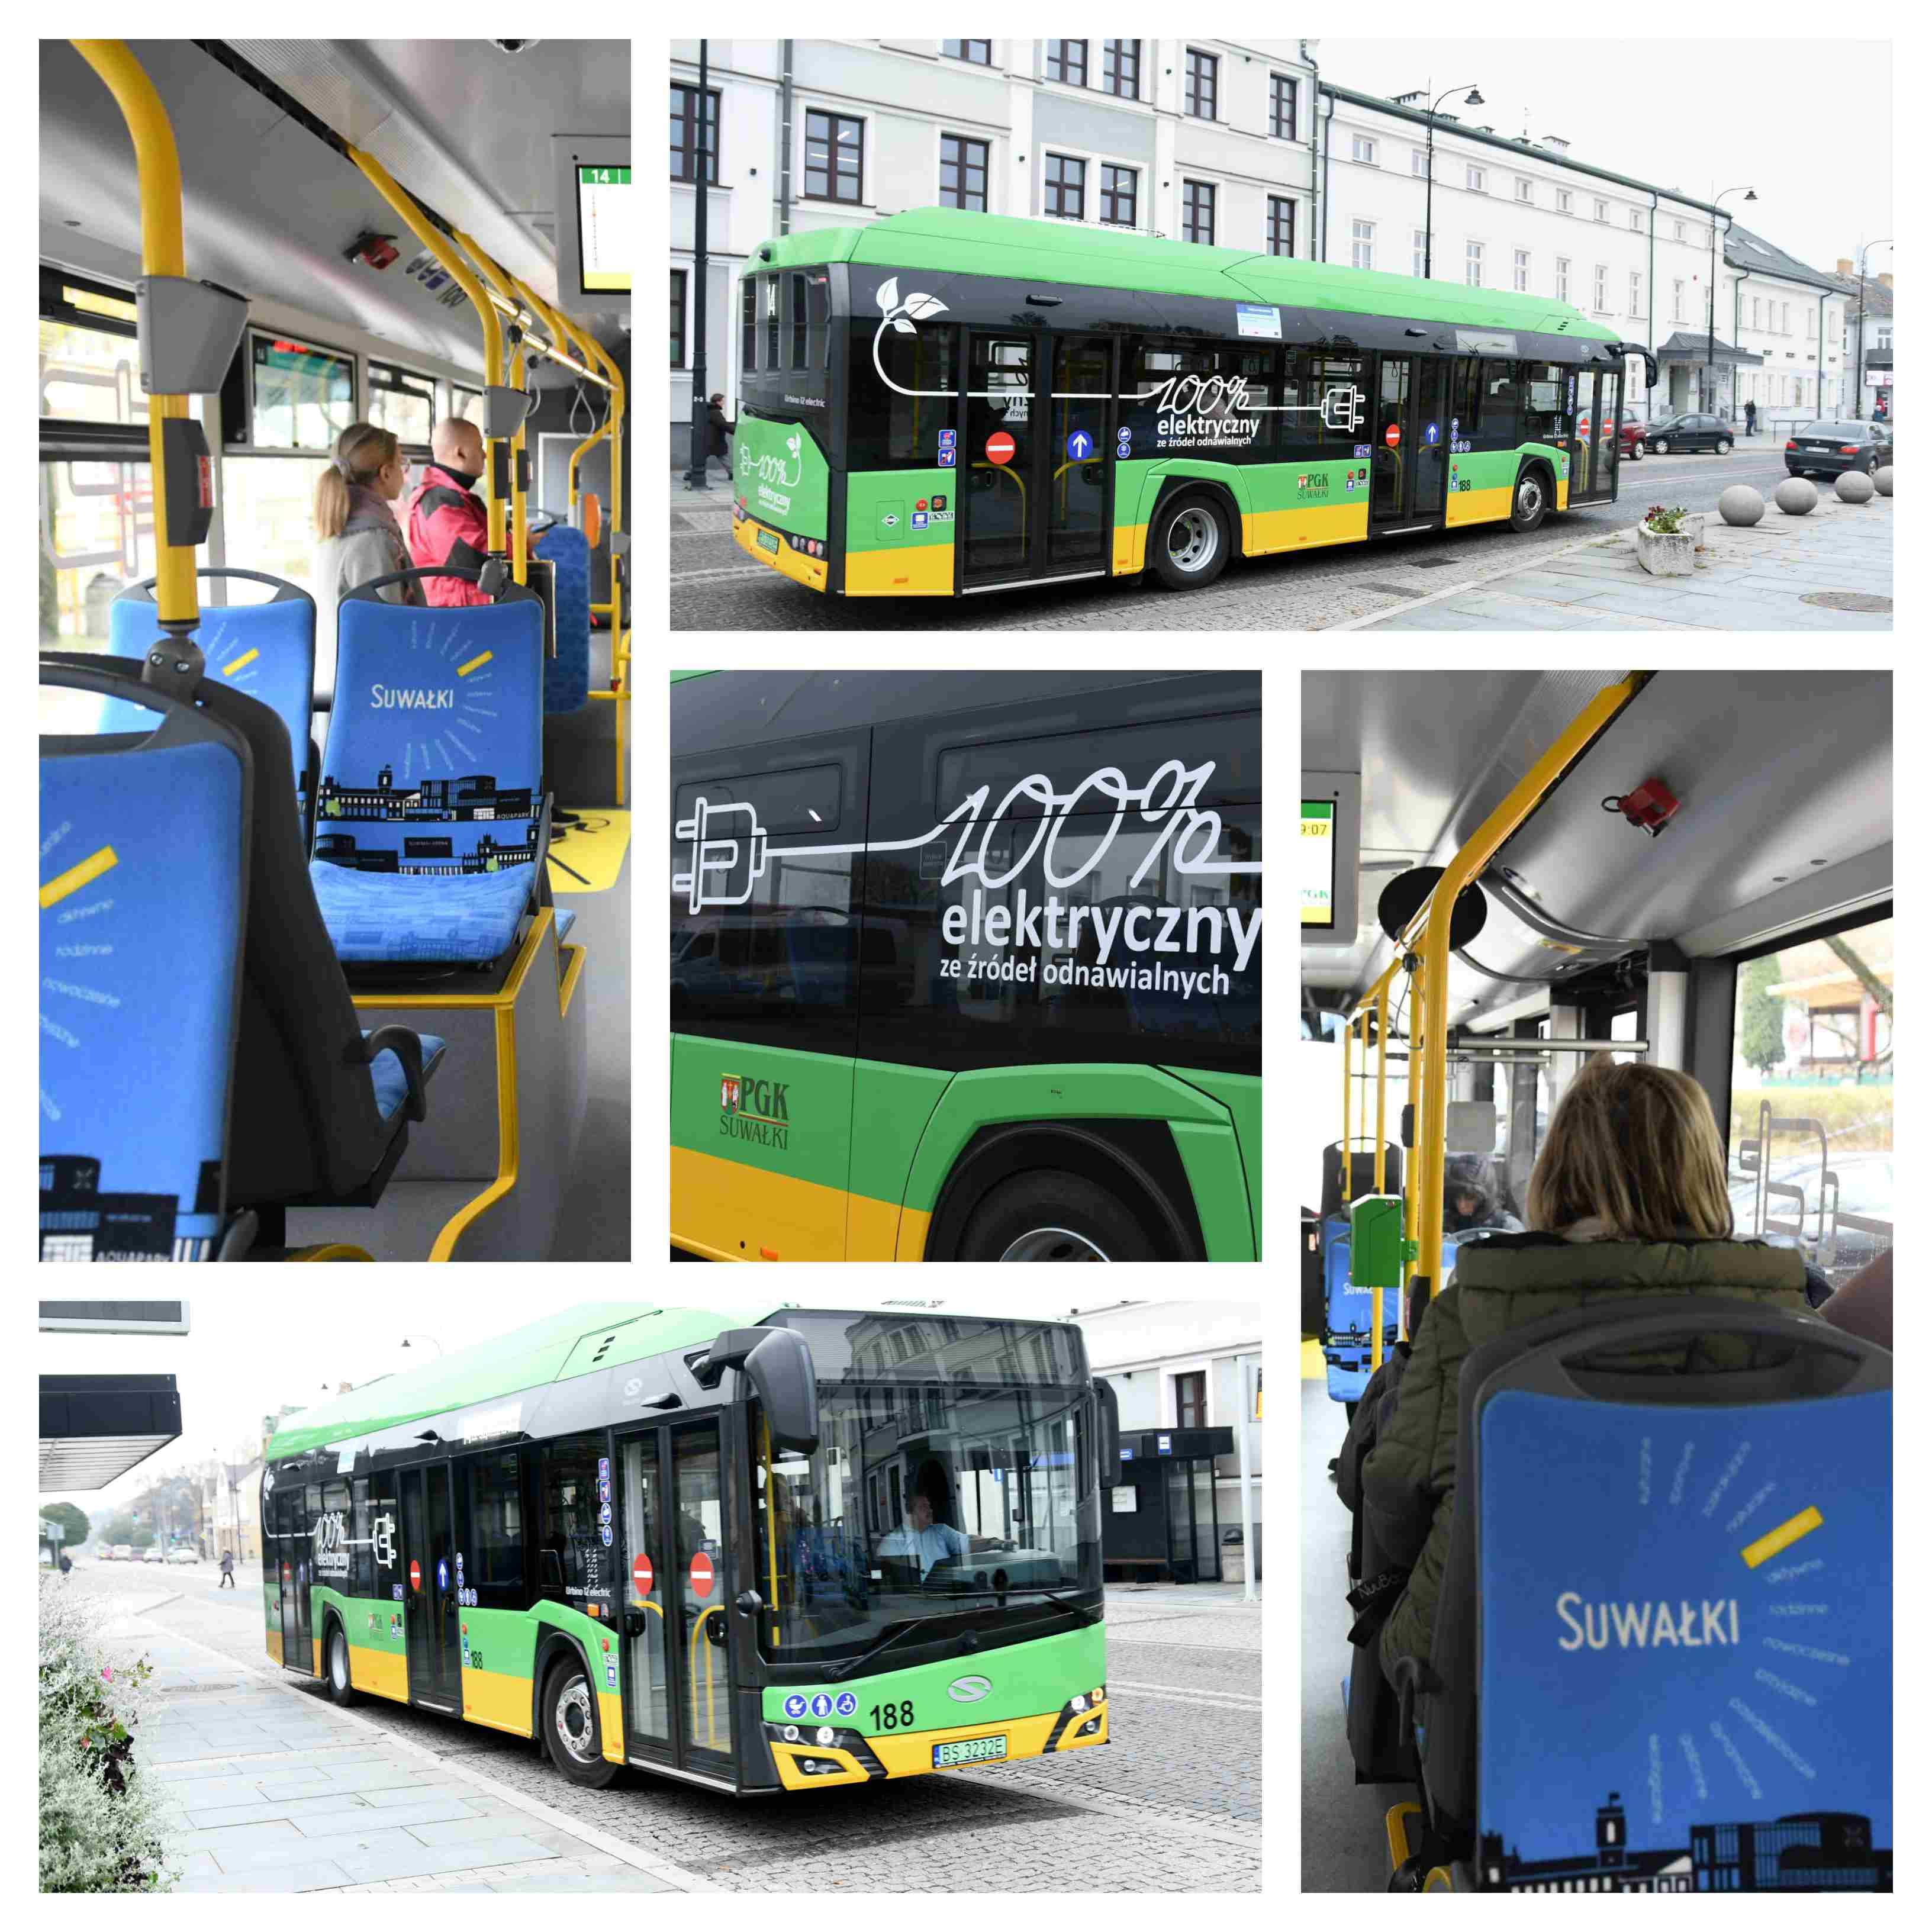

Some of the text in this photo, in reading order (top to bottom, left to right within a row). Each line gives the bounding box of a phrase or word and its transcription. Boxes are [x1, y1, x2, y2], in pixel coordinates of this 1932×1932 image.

[591, 169, 610, 183] 14
[805, 397, 826, 407] electric
[1157, 375, 1250, 415] 100%
[1157, 414, 1261, 438] elektryczny
[1168, 436, 1196, 447] źródeł
[1197, 435, 1252, 447] odnawialnych
[1307, 473, 1329, 488] PGK
[1459, 479, 1471, 492] 188
[941, 759, 1222, 888] 100%
[1302, 890, 1328, 899] GK
[942, 888, 1262, 972] elektryczny
[939, 953, 1230, 1000] ze źródeł odnawialnych
[739, 1076, 790, 1120] PGK
[719, 1114, 789, 1151] SUWAŁKI
[565, 1586, 583, 1596] Urbino
[590, 1587, 611, 1597] electric
[471, 1650, 483, 1670] 188
[870, 1699, 915, 1731] 188
[942, 1738, 1003, 1762] BS 3232E
